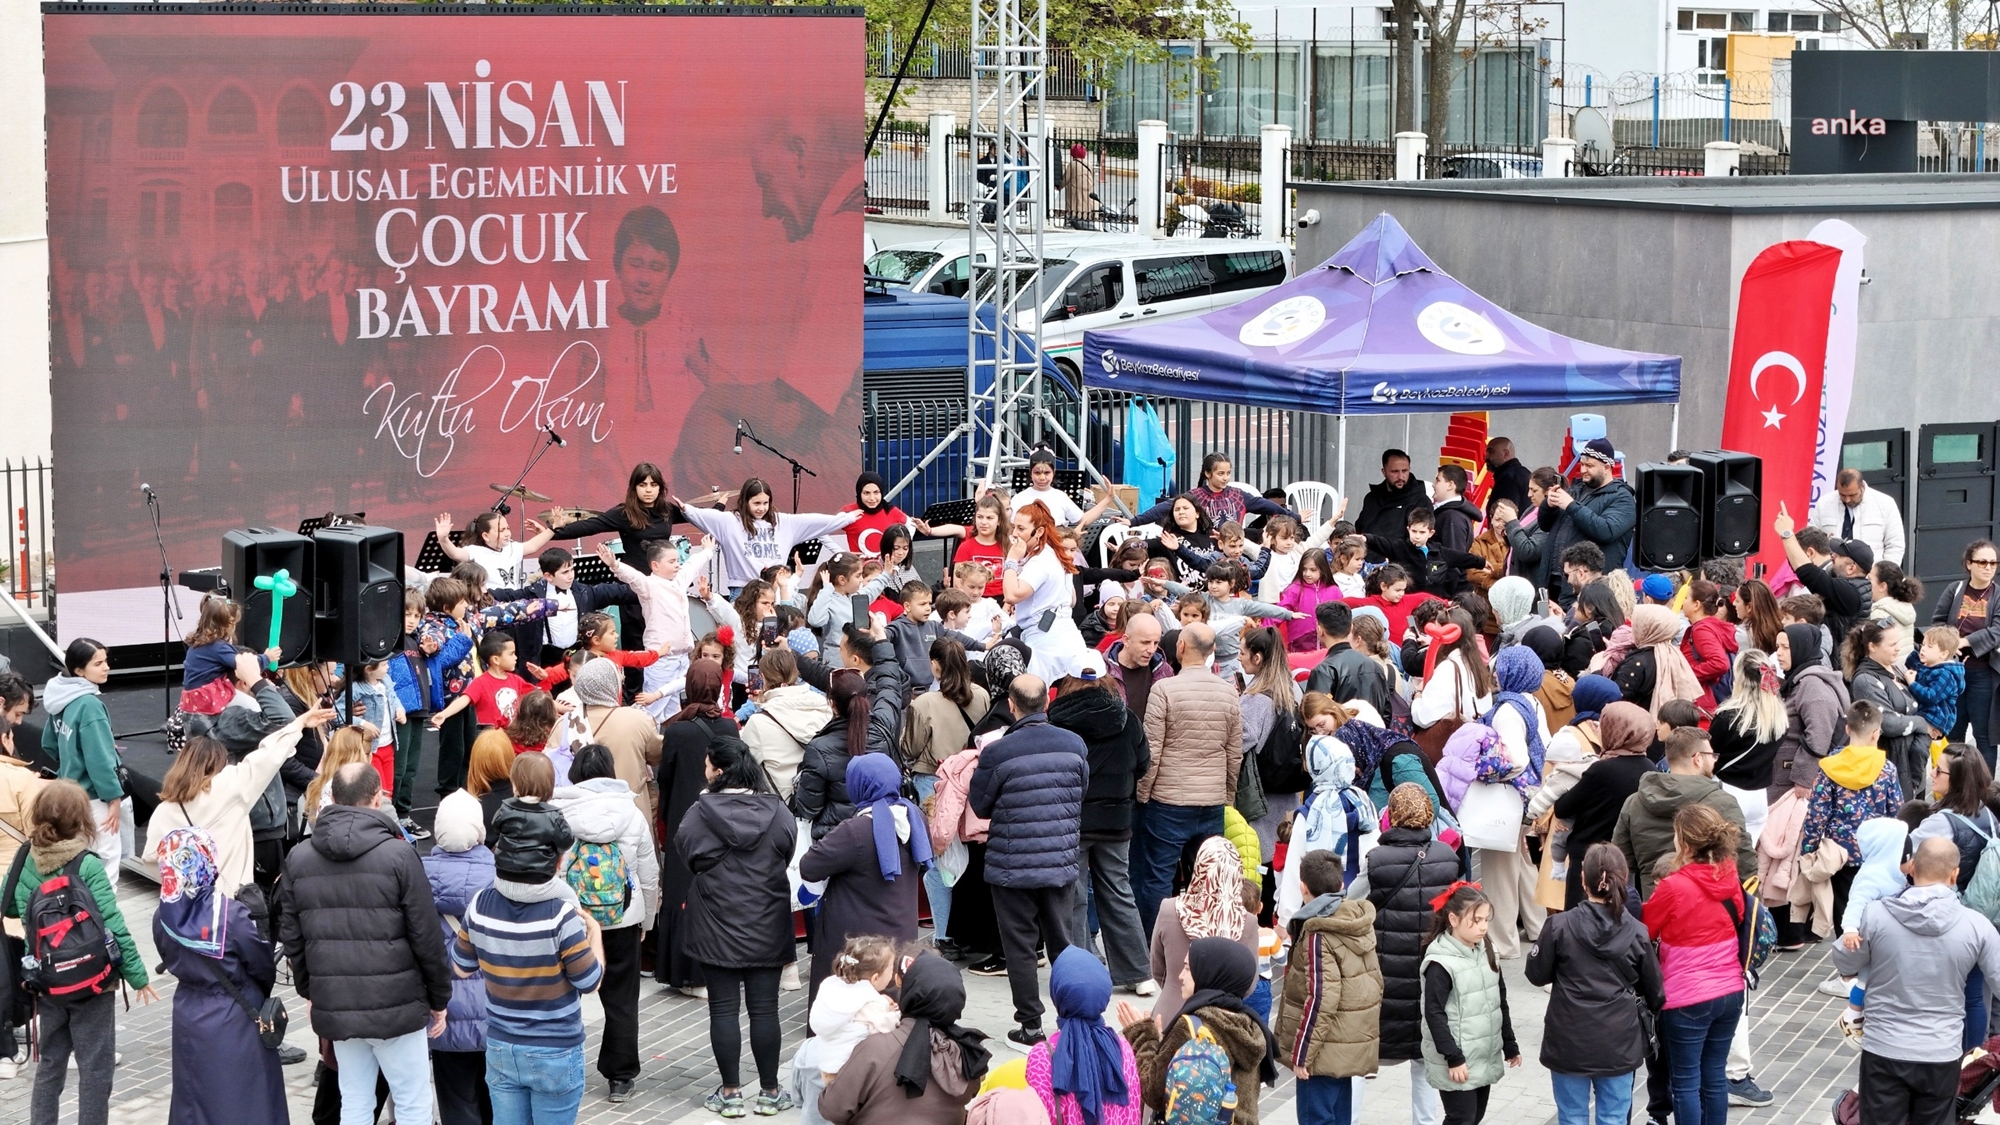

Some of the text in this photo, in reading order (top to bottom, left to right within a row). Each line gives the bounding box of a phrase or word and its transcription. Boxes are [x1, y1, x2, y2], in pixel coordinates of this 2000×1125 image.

[329, 60, 630, 152] 23 NİSAN
[280, 157, 679, 204] ULUSAL EGEMENLİK VE
[375, 208, 591, 285] ÇOCUK
[356, 280, 611, 340] BAYRAMI
[362, 340, 614, 478] Kutlu Olsun
